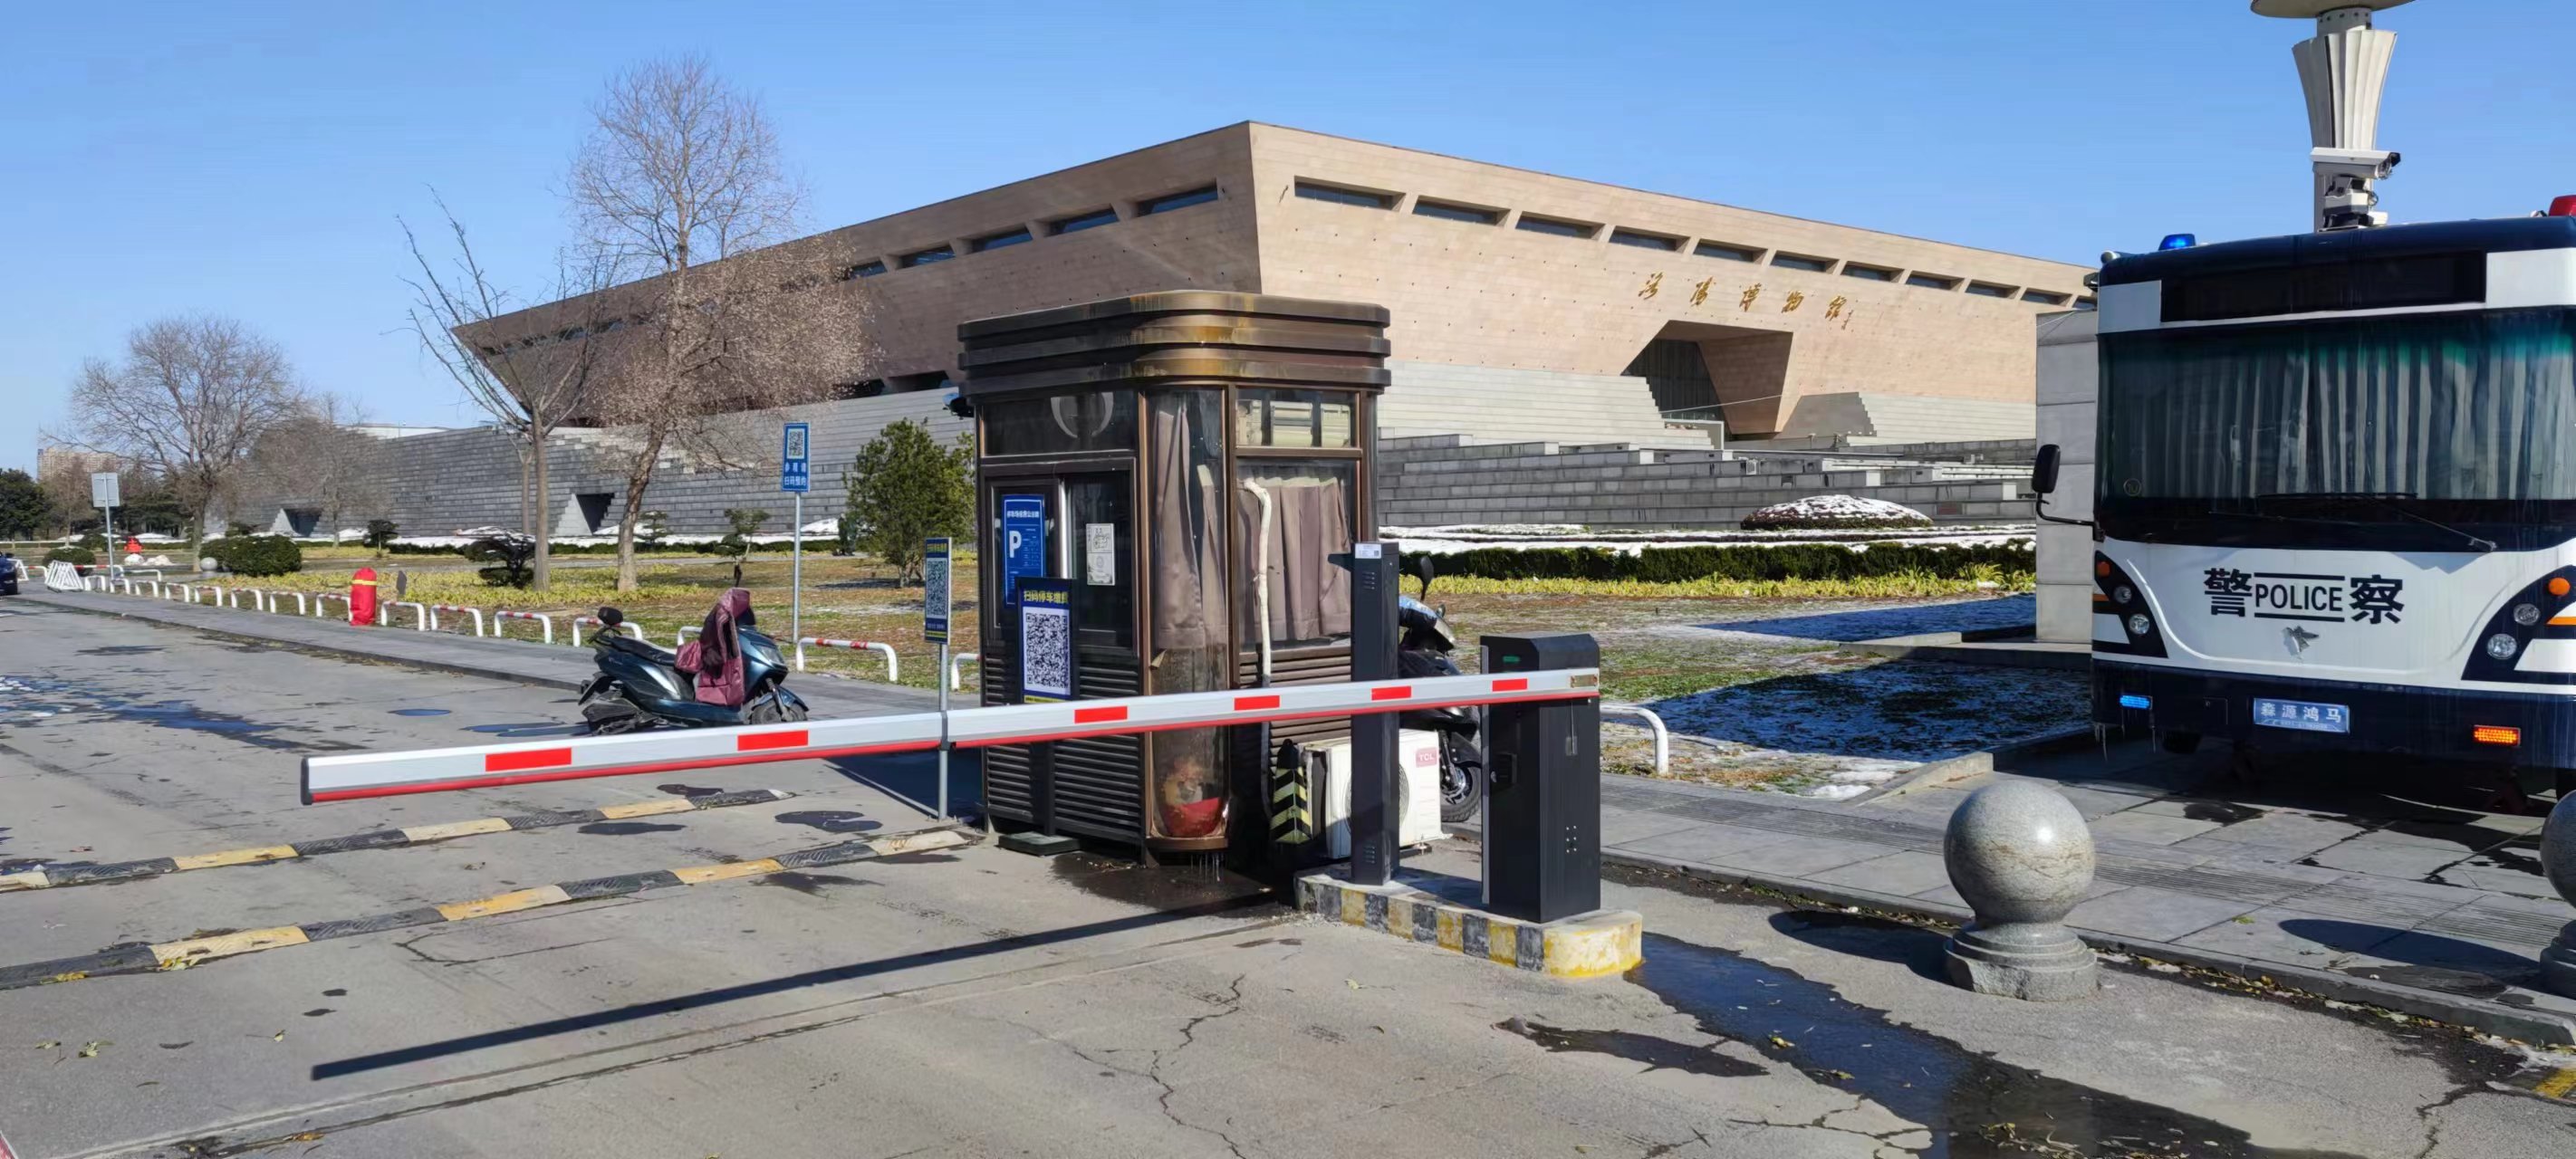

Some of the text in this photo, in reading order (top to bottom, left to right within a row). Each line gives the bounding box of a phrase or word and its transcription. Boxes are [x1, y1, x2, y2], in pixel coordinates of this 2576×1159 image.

[1009, 530, 1022, 559] P
[2255, 584, 2343, 612] POLICE
[1419, 753, 1435, 761] TCL
